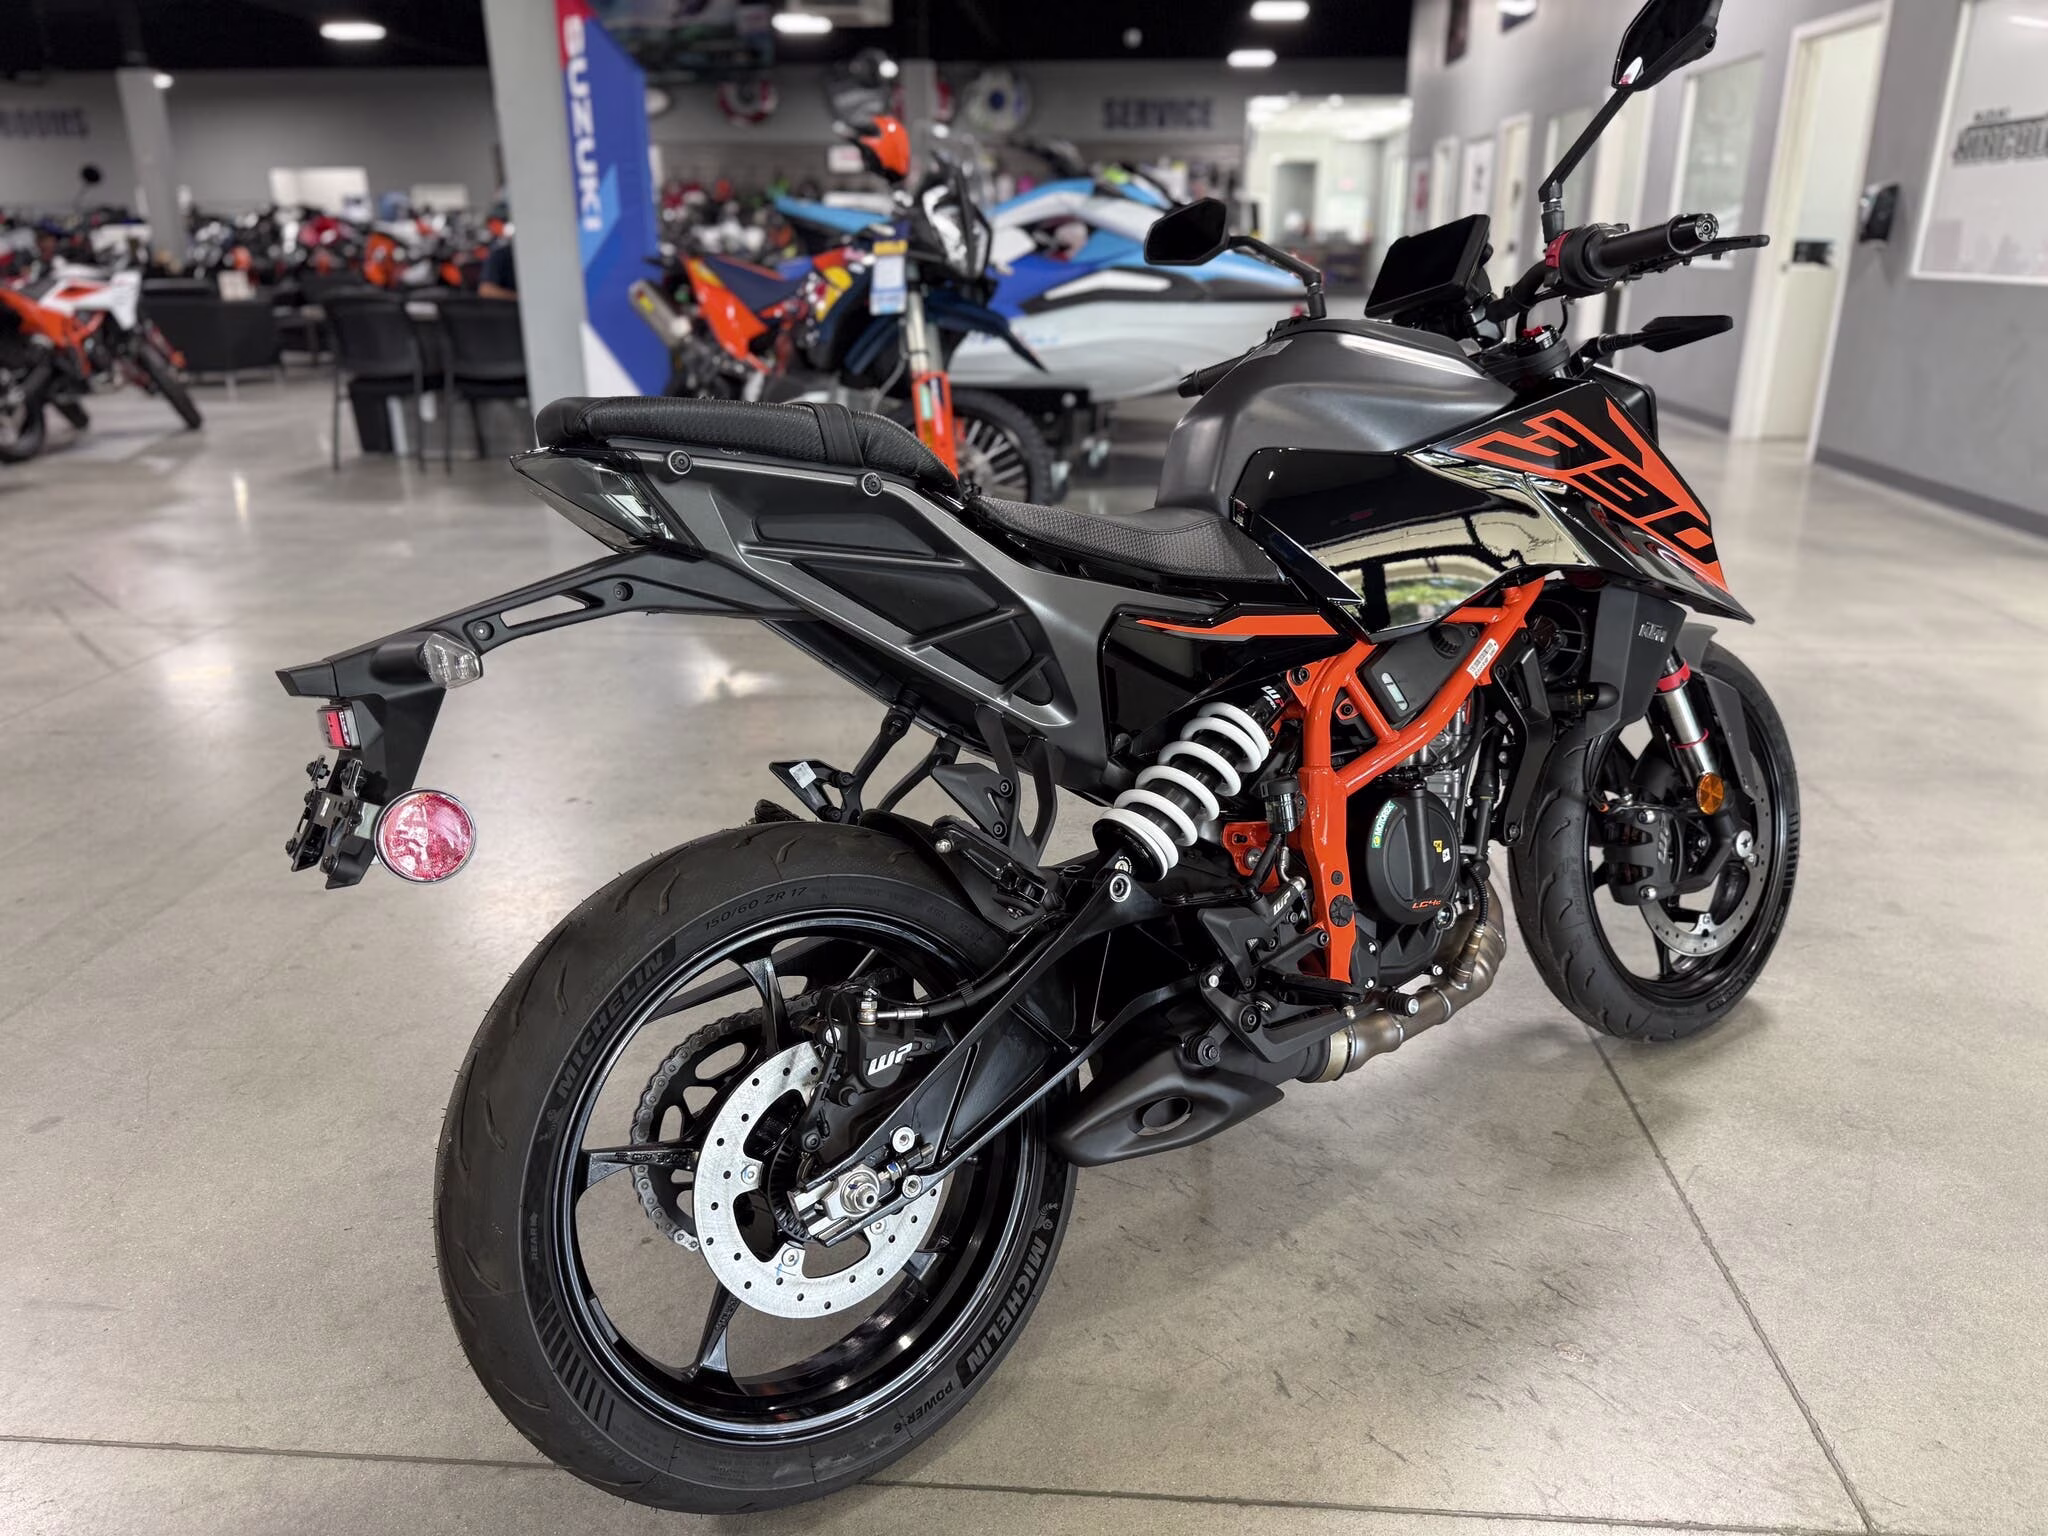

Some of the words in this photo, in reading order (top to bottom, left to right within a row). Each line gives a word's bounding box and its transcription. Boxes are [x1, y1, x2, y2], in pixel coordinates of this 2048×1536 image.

[563, 15, 602, 231] SUZUKI
[1638, 620, 1669, 643] KTM
[1375, 800, 1396, 837] MOTOREX
[704, 899, 759, 931] 150/60
[763, 889, 788, 907] ZR
[791, 886, 808, 899] 17
[556, 950, 666, 1099] MICHELIN
[868, 1042, 913, 1076] WP
[965, 1236, 1048, 1375] MICHELIN
[906, 1381, 954, 1426] POWER
